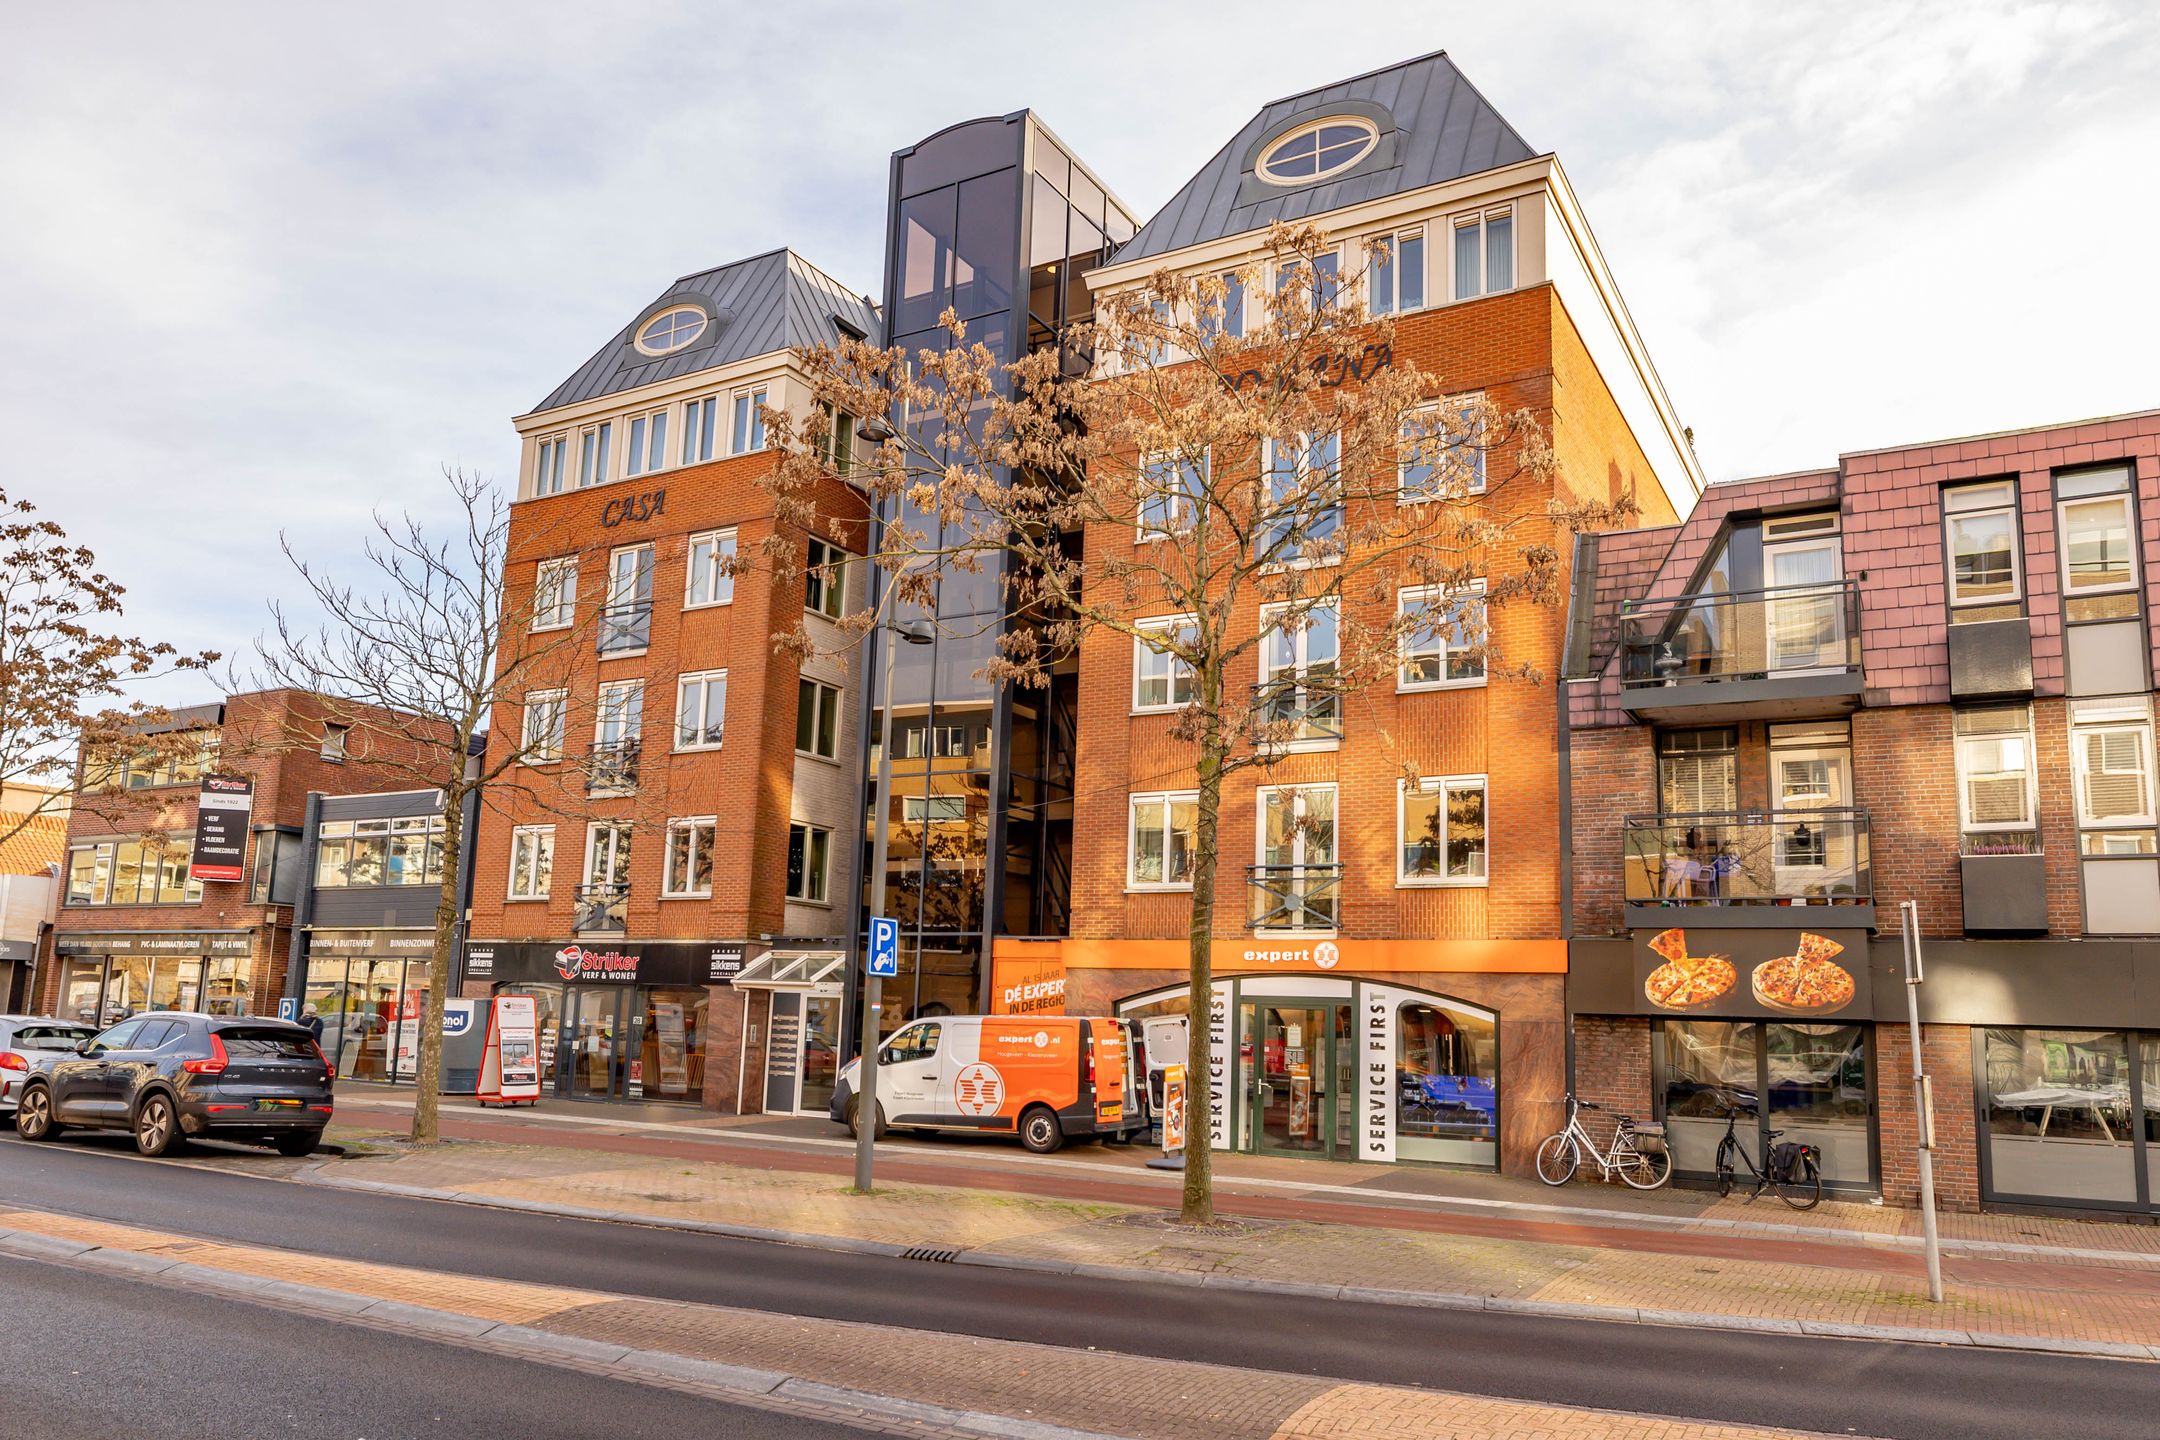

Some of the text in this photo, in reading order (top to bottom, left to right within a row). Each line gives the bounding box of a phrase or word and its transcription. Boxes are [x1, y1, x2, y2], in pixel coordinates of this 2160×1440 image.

[602, 487, 666, 528] CASA
[310, 939, 375, 948] BINNEN- & BUITENVERF
[876, 922, 892, 951] P
[112, 940, 131, 948] BEHANG
[212, 940, 227, 950] TAPIJT
[233, 940, 248, 949] VINYL
[469, 958, 493, 968] sikkens
[581, 950, 640, 971] Strijker
[1243, 949, 1310, 963] expert
[711, 960, 740, 971] sikkens
[582, 971, 637, 980] VERF & WONEN
[1023, 976, 1030, 984] AL
[1043, 969, 1059, 980] JAAR
[246, 991, 255, 1001] 32
[1005, 978, 1066, 1004] DÉ EXPER
[282, 1002, 292, 1019] P
[1009, 994, 1066, 1015] IN DE REGIO
[634, 1017, 642, 1025] 28
[998, 1035, 1033, 1044] expert
[1210, 991, 1225, 1140] SERVICE FIRST
[1370, 992, 1386, 1152] SERVICE FIRST
